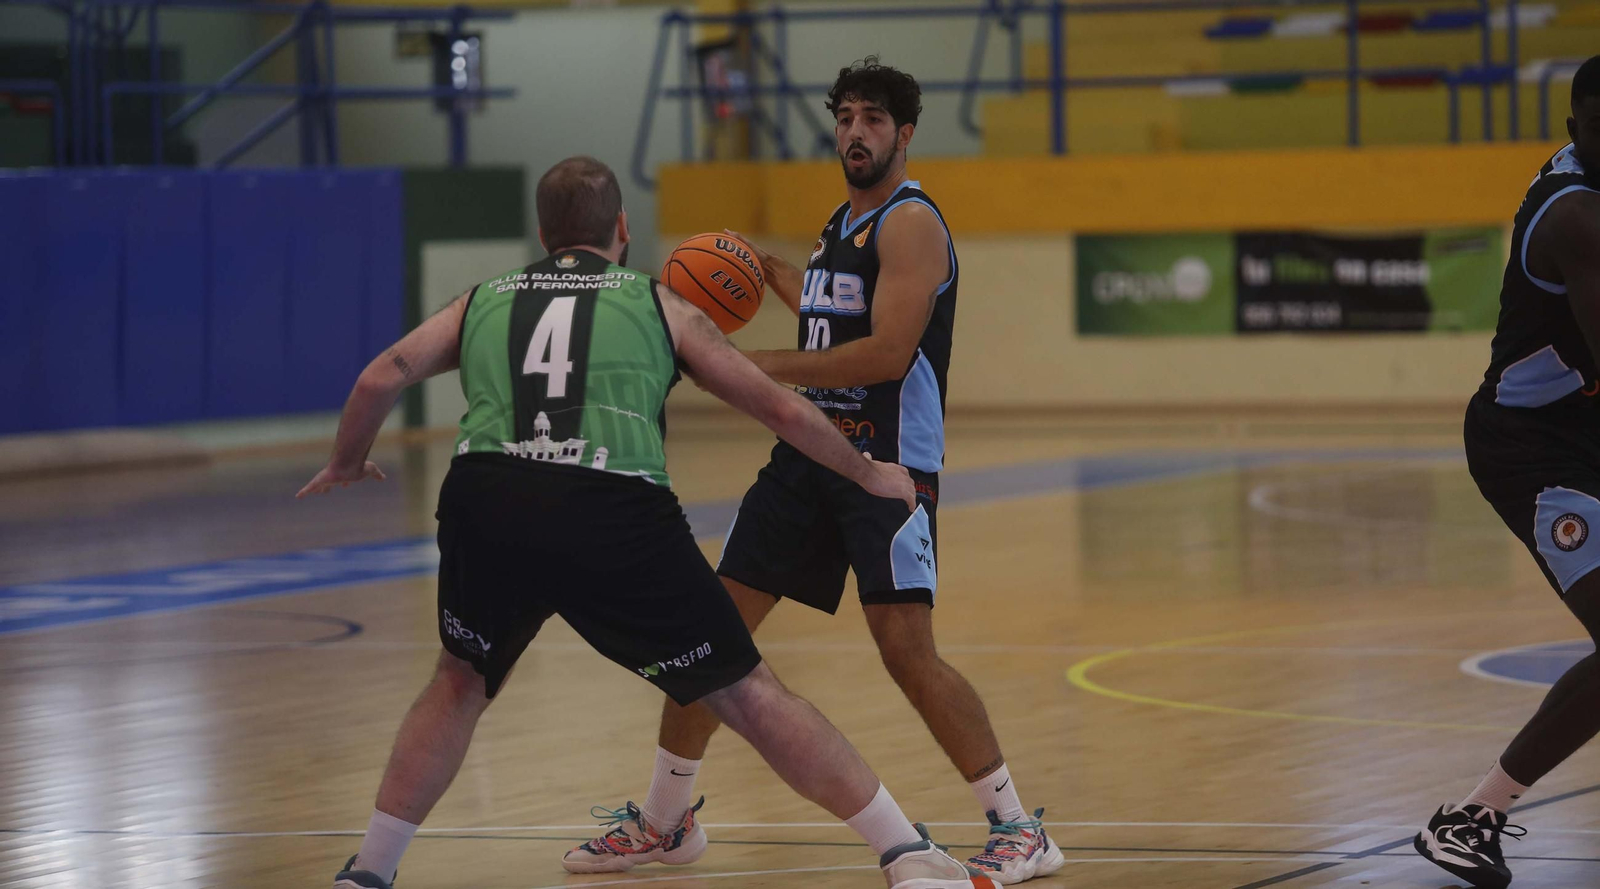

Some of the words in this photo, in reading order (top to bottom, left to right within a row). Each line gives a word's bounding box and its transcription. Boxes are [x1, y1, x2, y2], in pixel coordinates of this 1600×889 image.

[488, 272, 528, 288] CLUB
[530, 271, 636, 284] BALONCESTO
[714, 237, 765, 291] Wilson
[495, 281, 529, 294] SAN
[532, 280, 622, 292] FERNANDO
[799, 268, 867, 316] ULB
[522, 296, 576, 399] 4
[804, 317, 832, 351] 10
